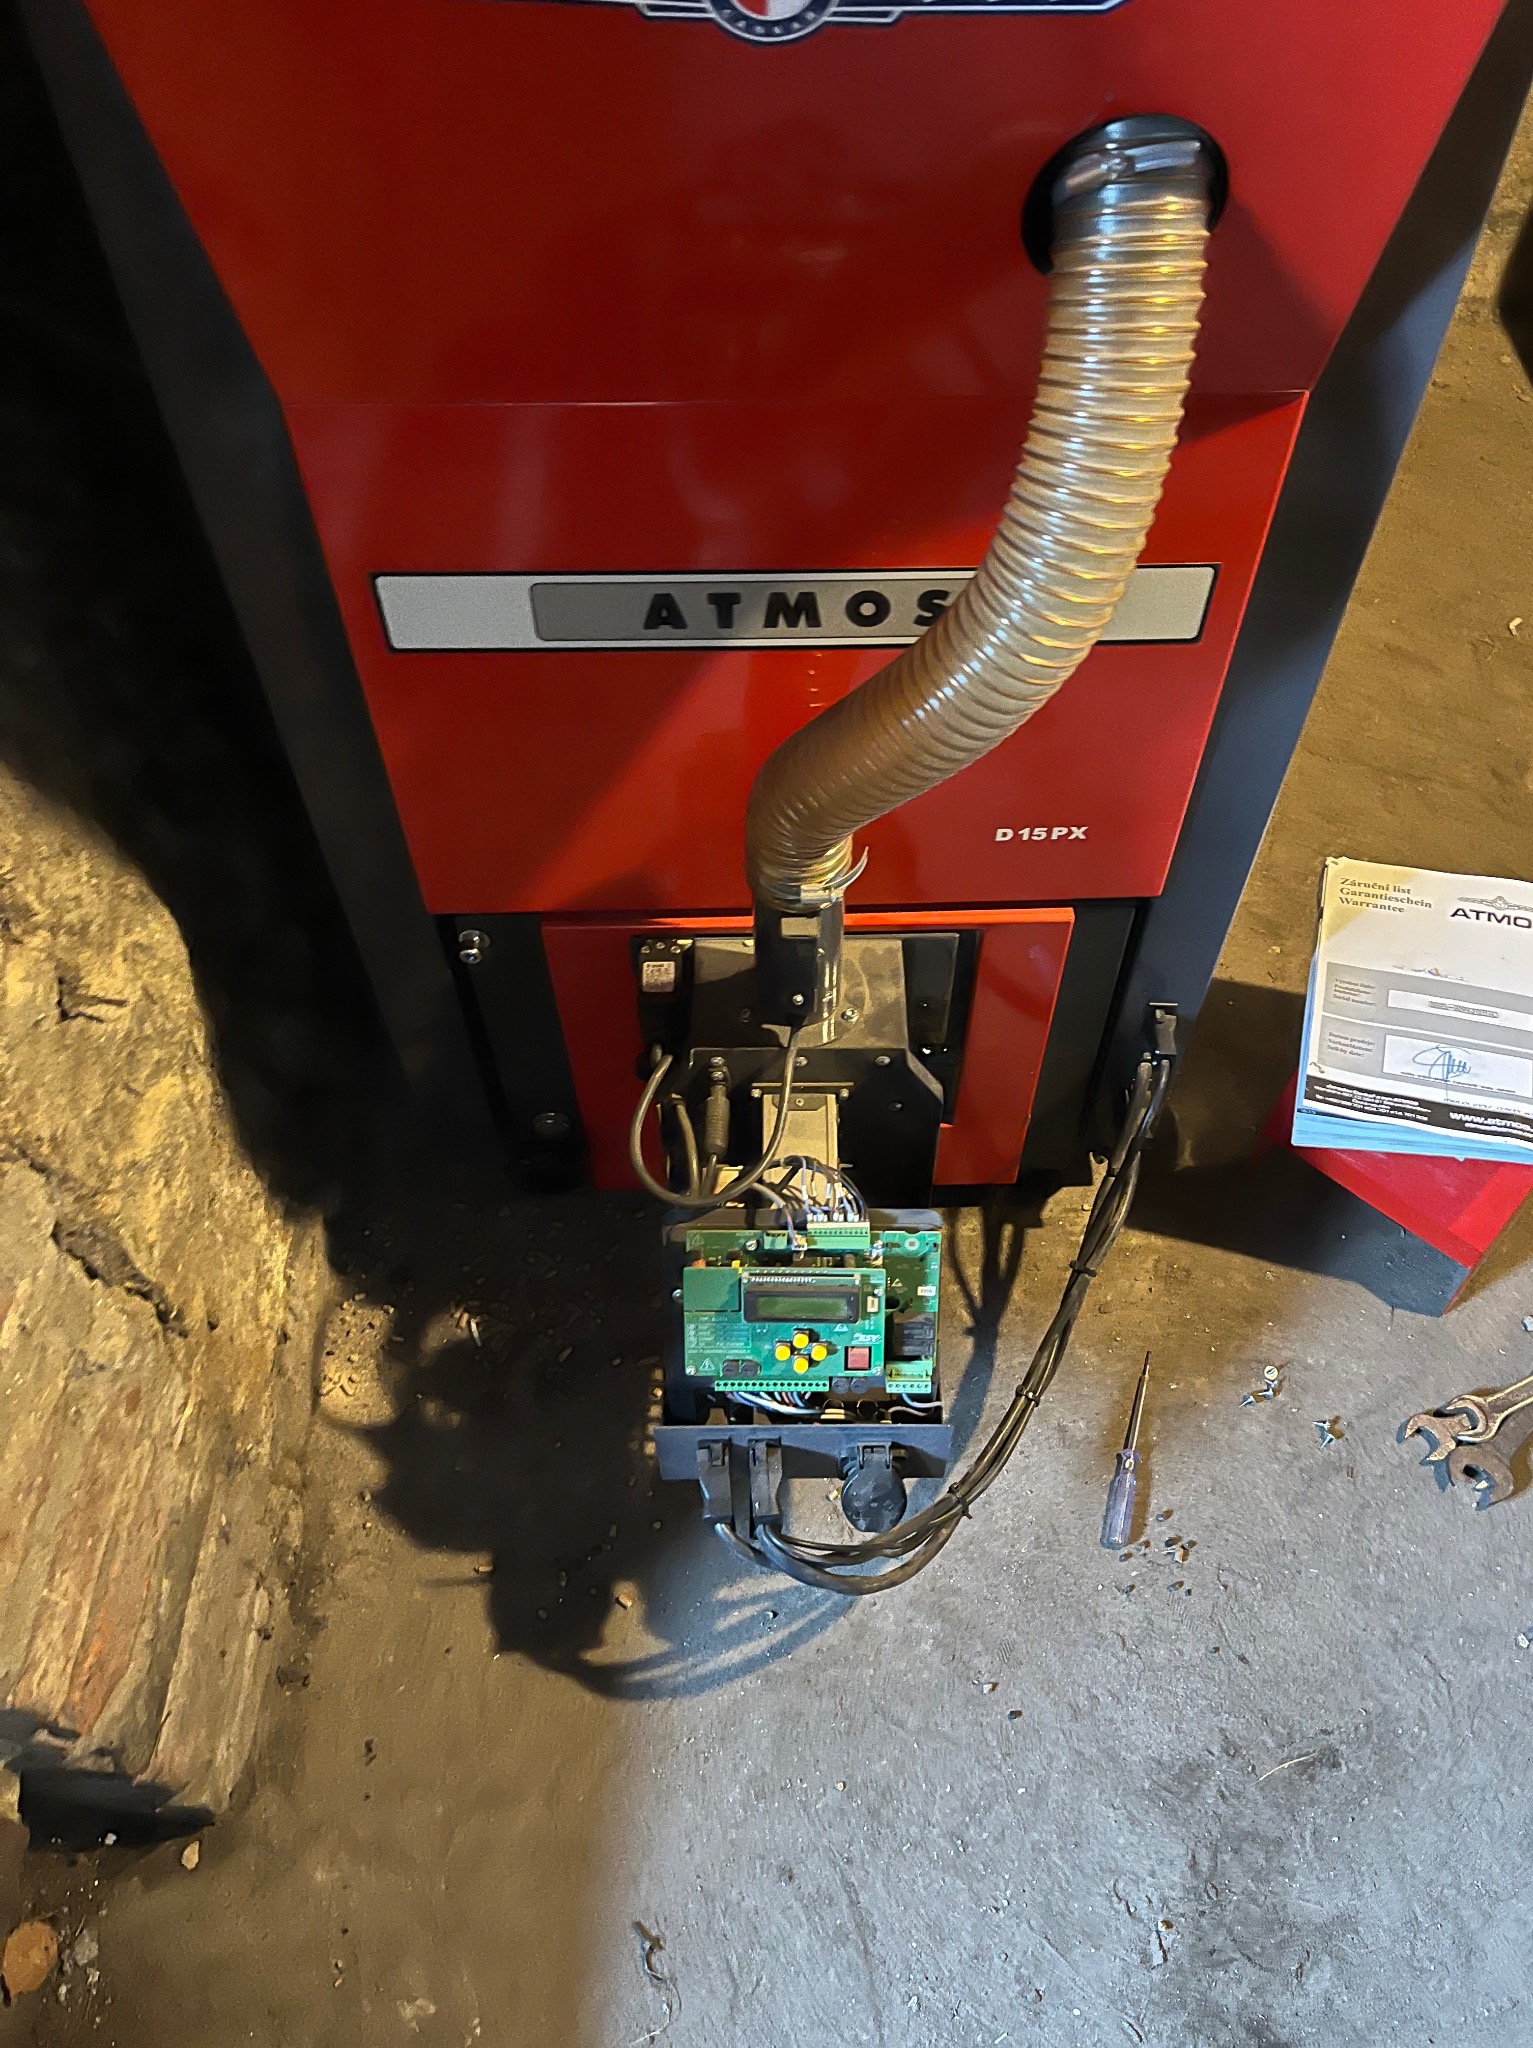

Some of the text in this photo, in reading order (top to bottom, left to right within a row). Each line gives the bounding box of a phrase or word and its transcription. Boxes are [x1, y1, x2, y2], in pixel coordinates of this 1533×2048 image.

[643, 589, 951, 631] ATMOS
[1340, 877, 1412, 895] Záruční list
[1339, 896, 1405, 913] Warrantee
[1340, 887, 1432, 908] Garantieschein
